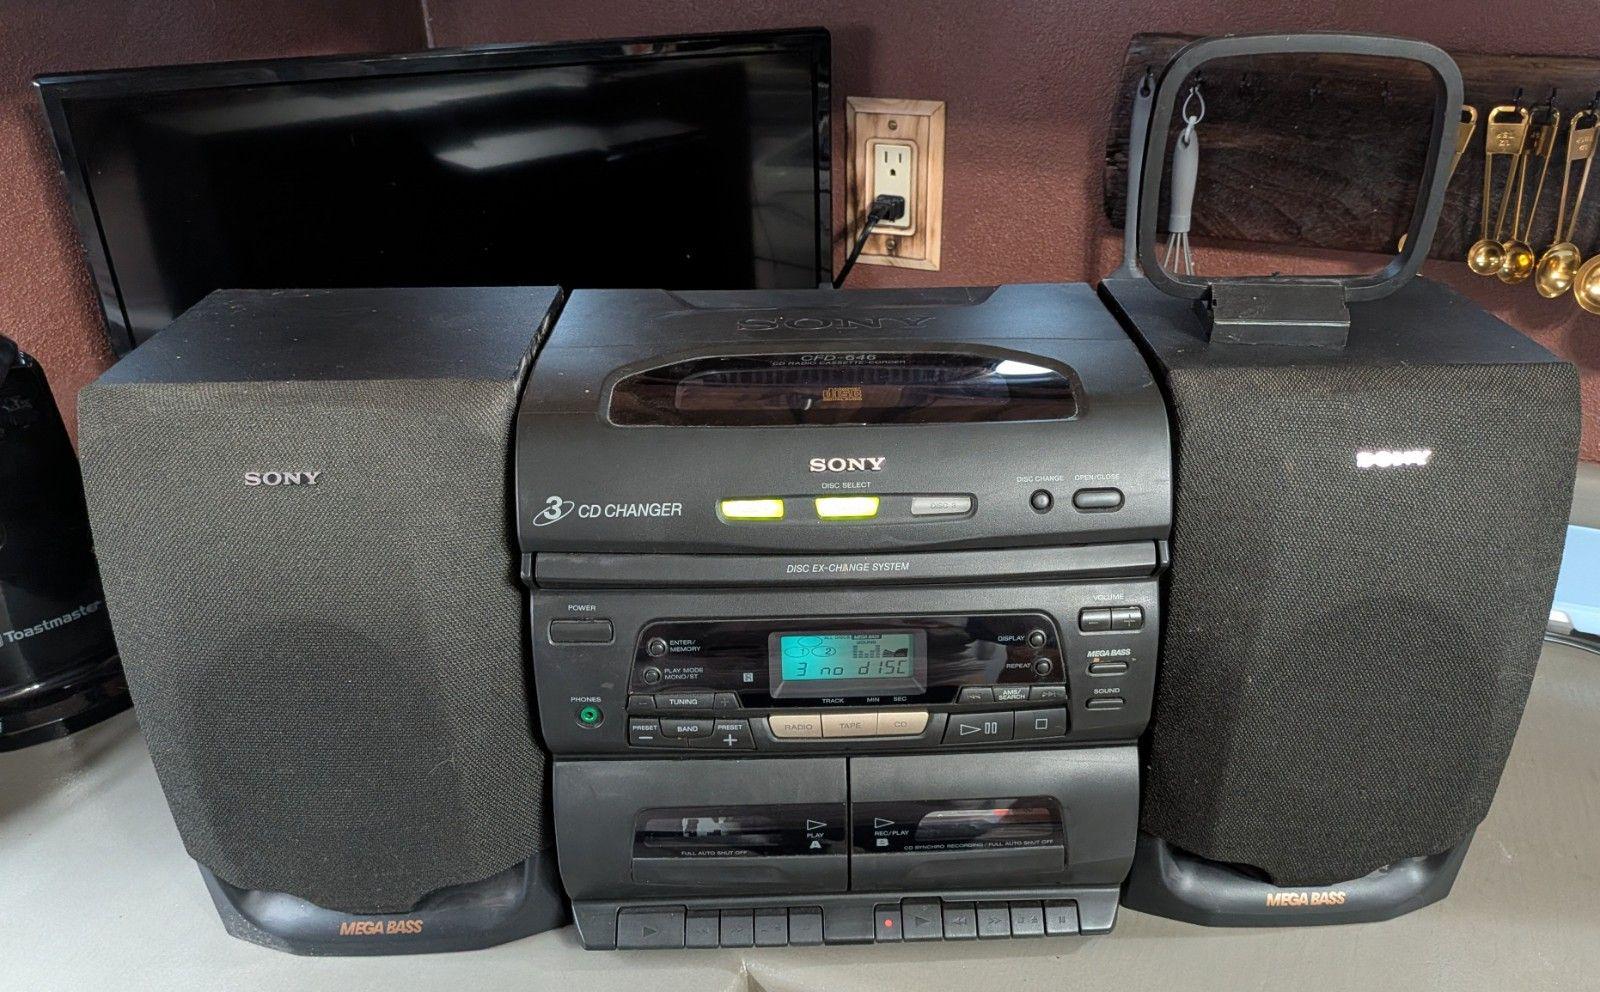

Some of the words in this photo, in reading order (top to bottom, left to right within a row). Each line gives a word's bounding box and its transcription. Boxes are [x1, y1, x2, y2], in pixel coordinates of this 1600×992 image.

[800, 353, 877, 362] CFD-646
[809, 457, 886, 472] SONY
[244, 471, 321, 486] SONY
[1016, 475, 1034, 483] DISC
[1034, 474, 1063, 482] CHANGE
[1074, 472, 1120, 481] OPEN/CLOSE
[842, 481, 871, 489] SELECT
[578, 504, 601, 518] CD
[604, 503, 682, 517] CHANGER
[786, 564, 810, 573] DISC
[811, 562, 870, 573] EX-CHANGE
[871, 561, 910, 571] SYSTEM
[1092, 593, 1125, 601] VOLUME
[567, 603, 597, 612] POWER
[669, 638, 697, 646] ENTER/
[997, 634, 1026, 643] DISPLAY
[669, 644, 701, 653] MEMORY
[1086, 650, 1110, 658] MEGA
[1110, 648, 1131, 657] BASS
[681, 666, 704, 674] MODE
[1005, 661, 1032, 670] REPEAT
[819, 666, 844, 676] no
[664, 673, 699, 681] MONO/ST
[1002, 687, 1022, 695] AMS/
[1093, 687, 1121, 695] SOUND
[570, 695, 602, 704] PHONES
[893, 695, 908, 703] SEC
[998, 692, 1026, 701] SEARCH
[669, 697, 698, 706] TUNING
[632, 723, 658, 732] PRESET
[717, 723, 743, 732] PRESET
[784, 722, 813, 732] RADIO
[839, 720, 862, 730] TAPE
[893, 719, 908, 729] CD
[676, 724, 698, 734] BAND
[874, 829, 909, 837] REC/PLAY
[914, 843, 945, 852] SYNCHRO
[1265, 891, 1309, 907] MEGA
[1310, 890, 1346, 906] BASS
[339, 920, 384, 936] MEGA
[386, 919, 423, 934] BASS
